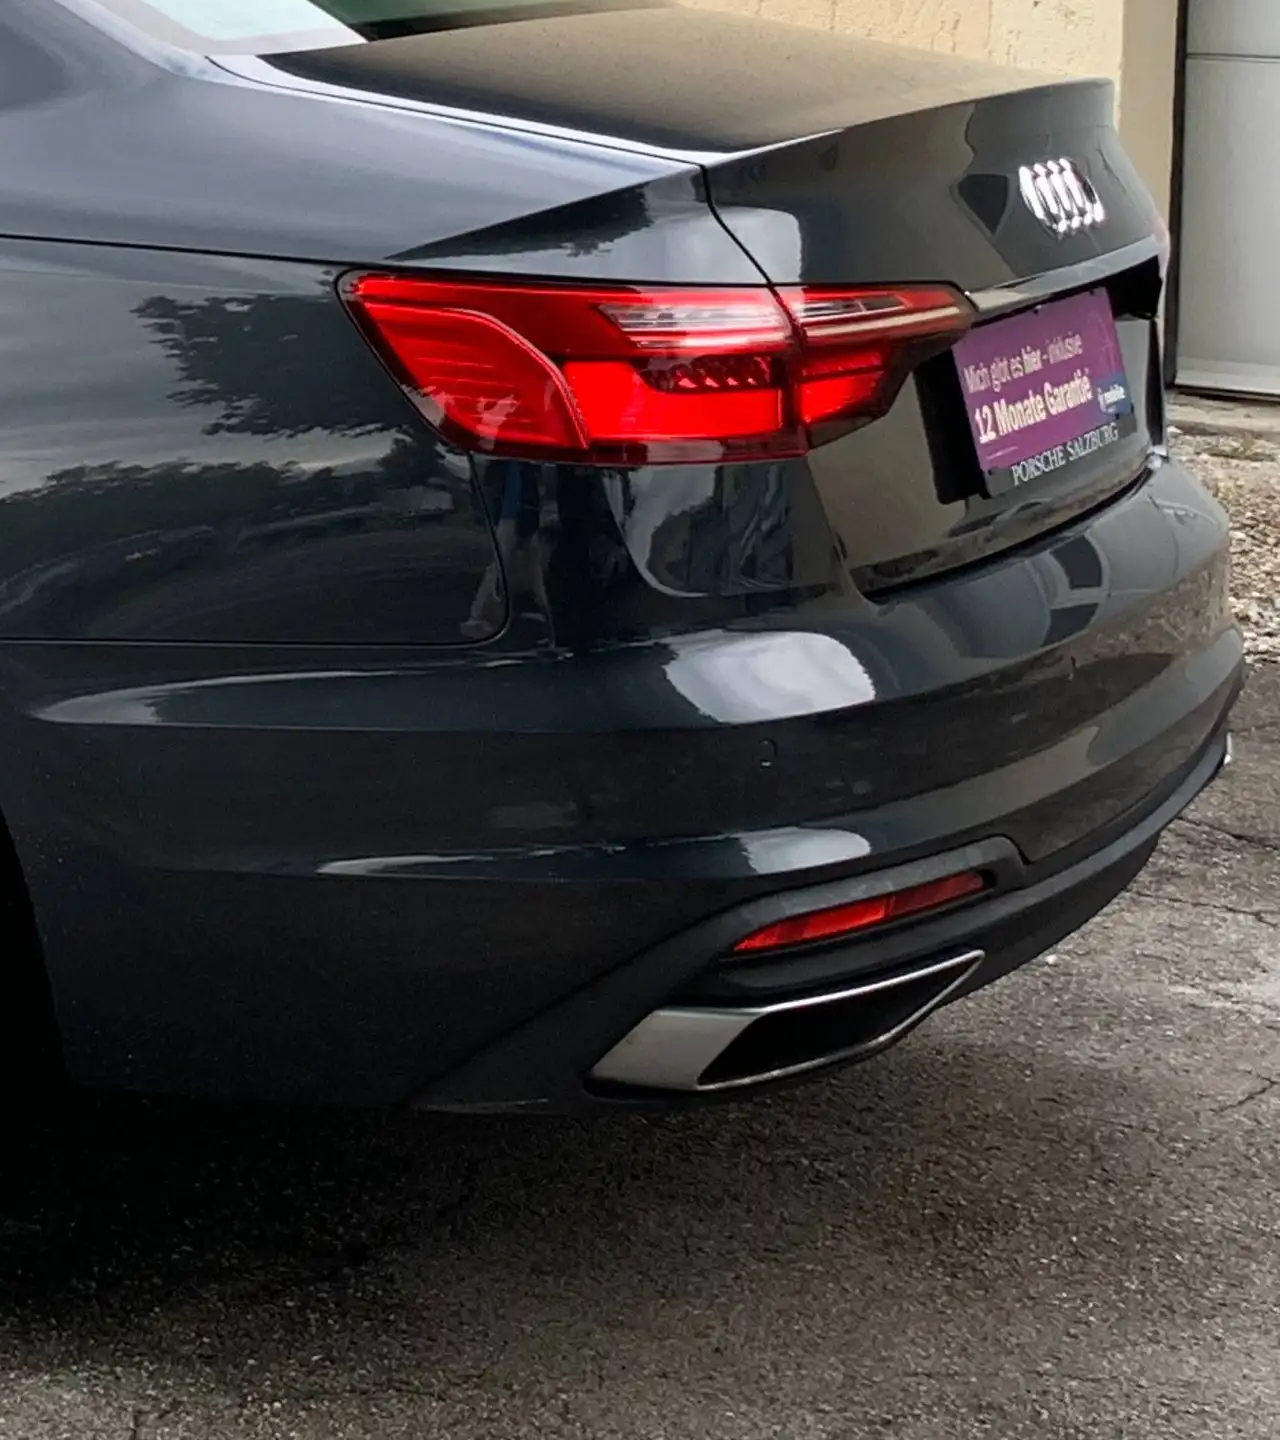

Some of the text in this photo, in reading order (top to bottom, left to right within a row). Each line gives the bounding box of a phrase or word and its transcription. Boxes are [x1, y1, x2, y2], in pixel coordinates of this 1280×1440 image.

[963, 362, 991, 394] Mich
[990, 355, 1012, 393] gibt
[1011, 357, 1024, 378] es
[1021, 345, 1043, 373] hier
[973, 406, 997, 444] 12
[993, 388, 1048, 437] Monate
[1011, 422, 1120, 486] PORSCHE SALZBURG
